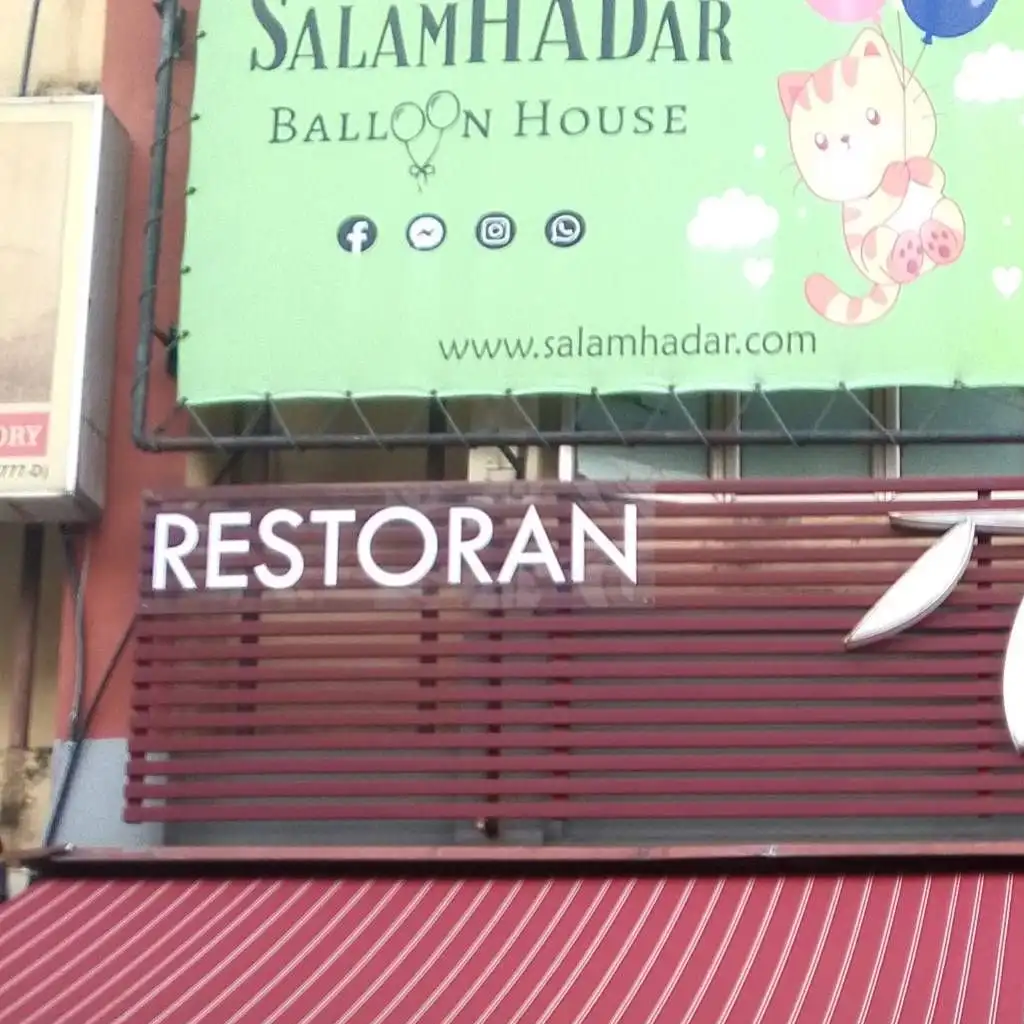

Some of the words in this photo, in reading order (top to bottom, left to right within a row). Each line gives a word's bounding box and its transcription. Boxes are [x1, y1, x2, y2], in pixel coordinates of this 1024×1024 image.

[514, 99, 689, 138] HOUSE
[438, 324, 818, 362] www.salamhadar.com
[152, 502, 638, 590] RESTORAN
